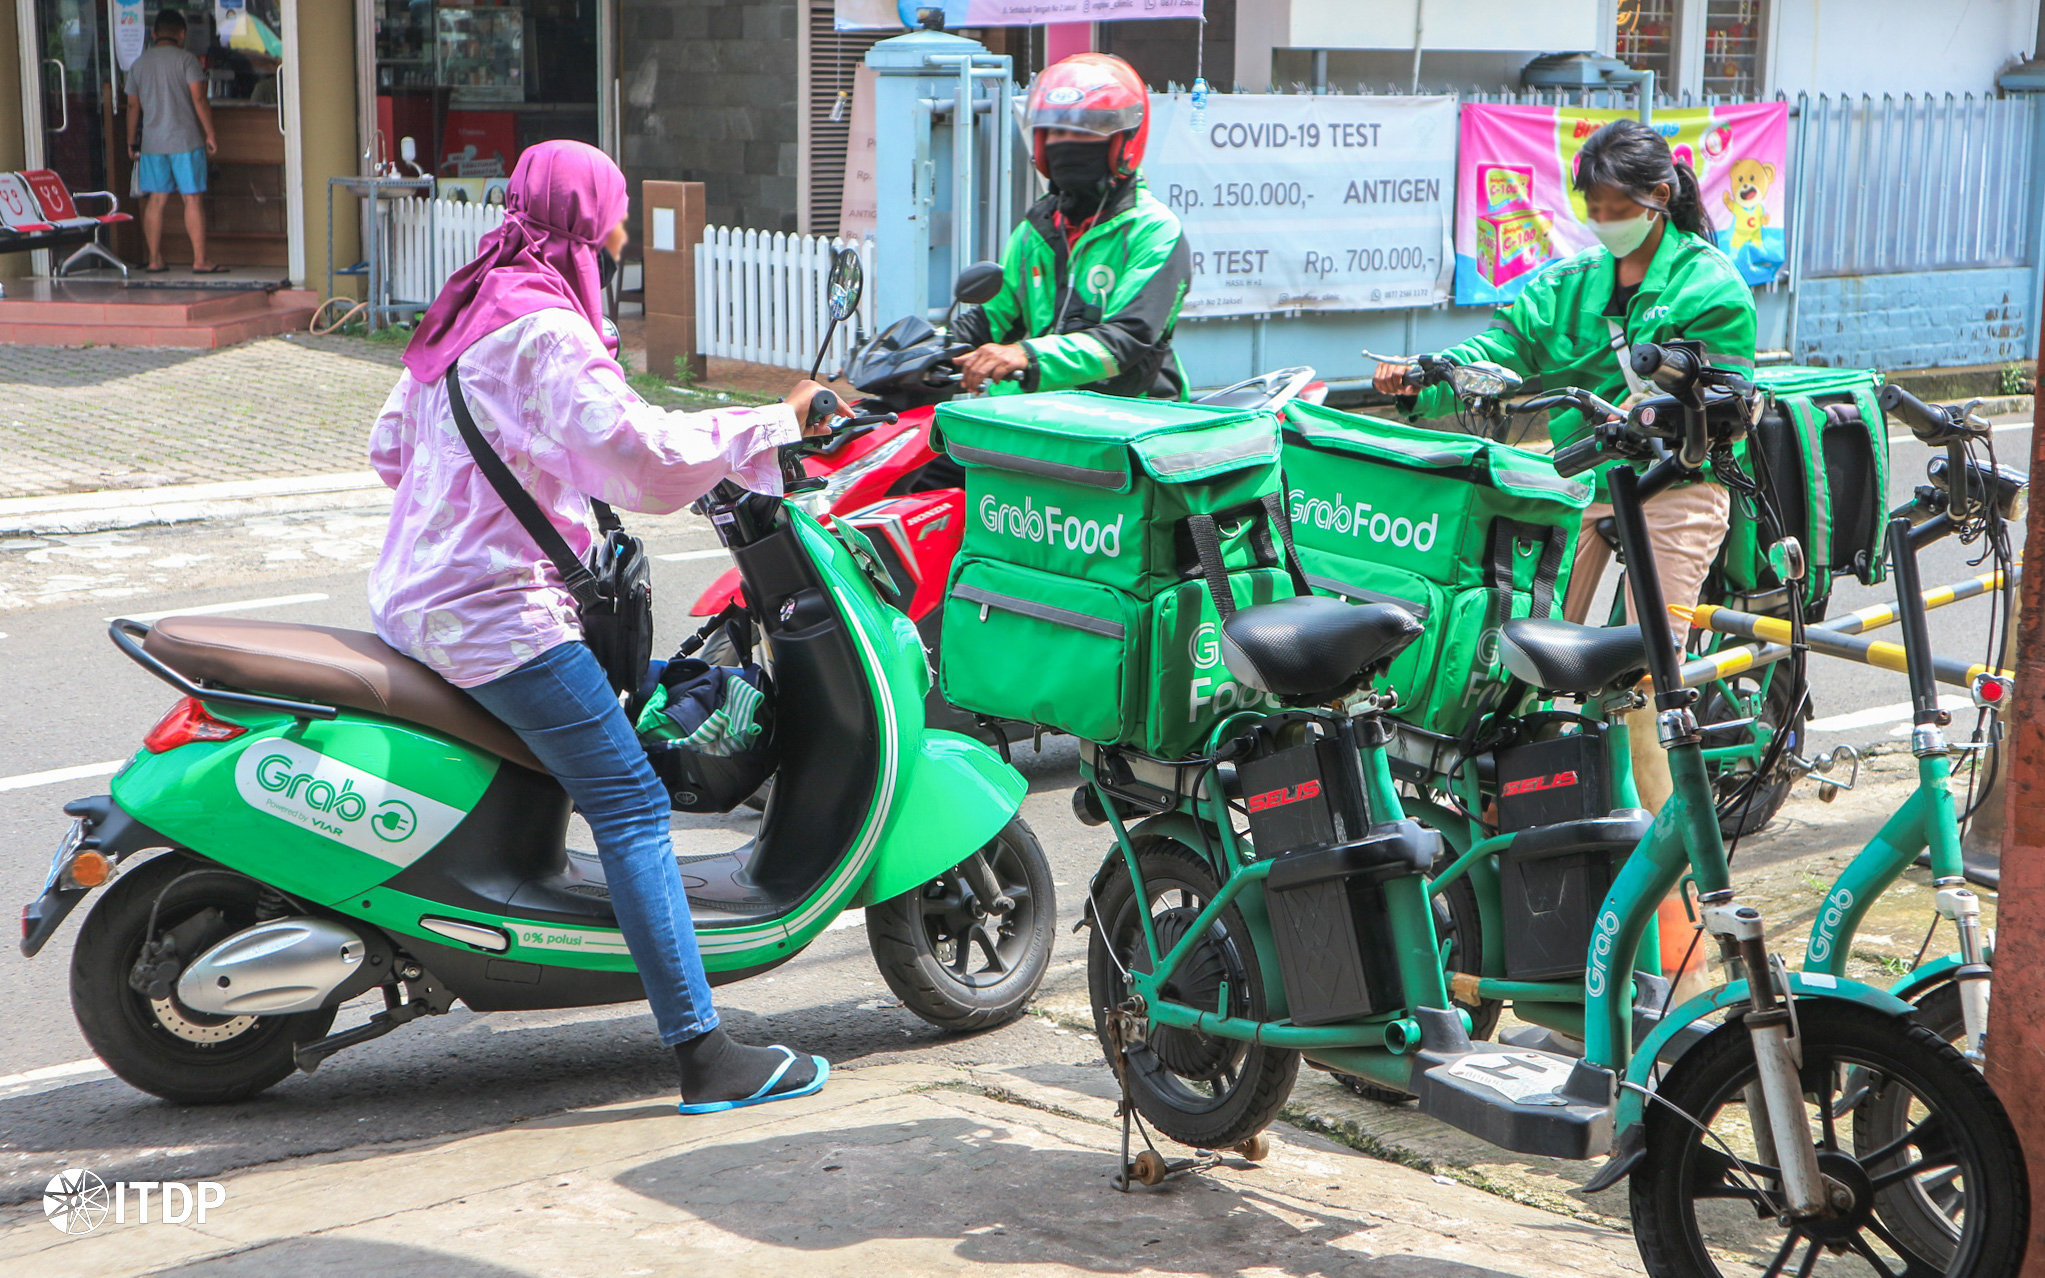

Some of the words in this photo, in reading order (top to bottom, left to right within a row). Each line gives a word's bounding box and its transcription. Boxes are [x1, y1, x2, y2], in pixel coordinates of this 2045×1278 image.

[1210, 122, 1320, 148] COVID-19
[1328, 122, 1382, 148] TEST
[1168, 183, 1204, 214] Rp.
[1212, 181, 1314, 209] 150.000,-
[1343, 178, 1441, 205] ANTIGEN
[848, 209, 877, 219] ANTIG
[1746, 217, 1756, 228] C
[1502, 227, 1537, 251] C-100
[1213, 249, 1270, 274] TEST
[1304, 250, 1339, 280] Rp.
[1346, 246, 1435, 273] 700.000,-
[906, 502, 954, 527] HONDA
[979, 493, 1125, 558] GrabFood
[256, 753, 366, 822] Grab
[1249, 779, 1321, 813] SELIS
[1502, 770, 1579, 798] SELIS
[265, 798, 298, 819] Powered
[298, 812, 309, 822] by
[312, 817, 343, 837] VIAR
[523, 931, 544, 945] 0%
[546, 933, 583, 947] polusi
[1807, 888, 1854, 963] Grab
[1585, 909, 1620, 998] Grab
